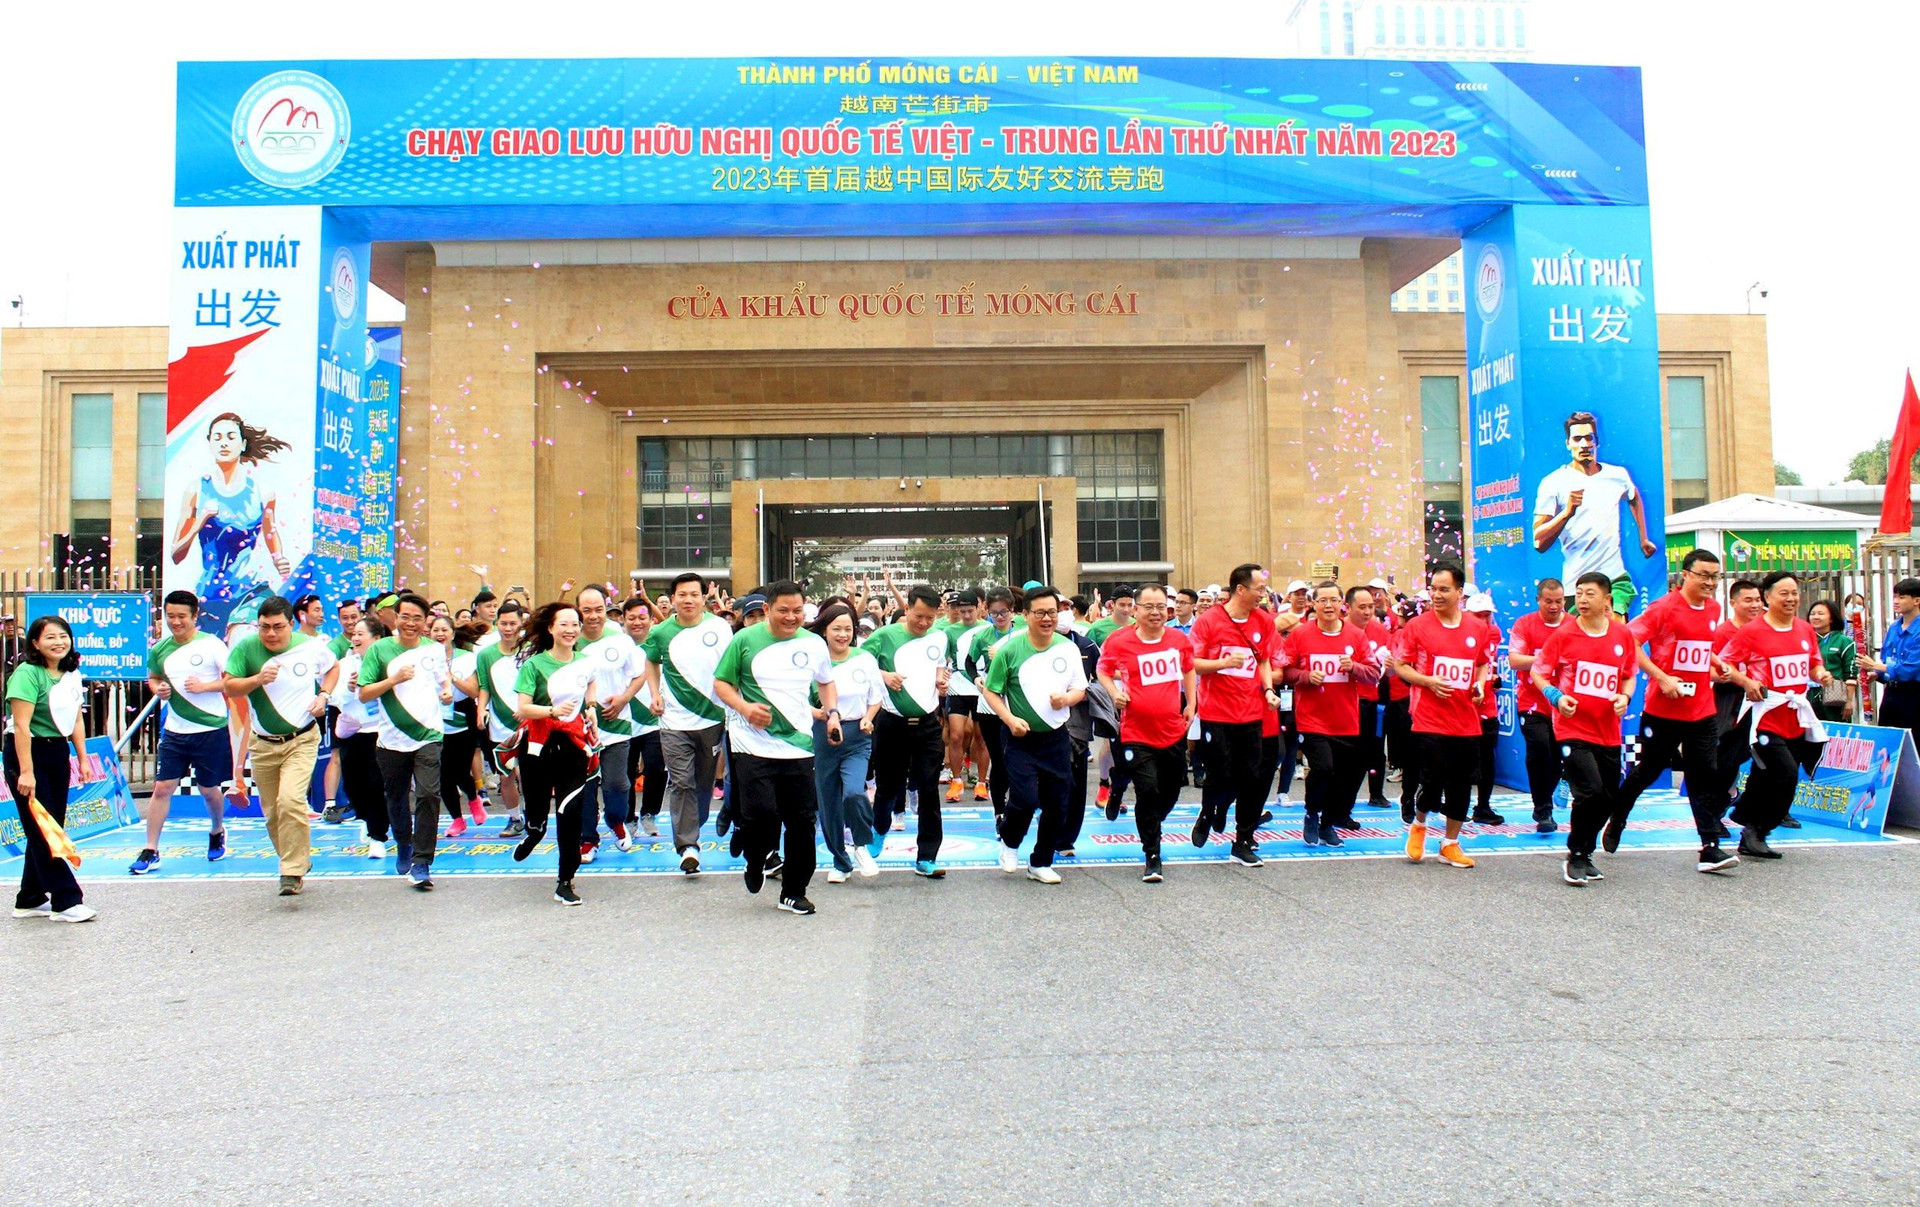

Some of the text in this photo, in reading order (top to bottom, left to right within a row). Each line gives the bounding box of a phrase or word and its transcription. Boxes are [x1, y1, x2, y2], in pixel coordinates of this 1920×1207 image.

[738, 61, 816, 84] THÀNH
[823, 60, 873, 84] PHỐ
[880, 62, 951, 84] MÓNG
[958, 62, 998, 84] CÁI
[1027, 63, 1077, 88] VIỆT
[1083, 65, 1138, 84] NAM
[839, 94, 991, 114] 越南芒街市
[407, 128, 483, 162] CHẠY
[491, 129, 560, 156] GIAO
[568, 127, 624, 155] LƯU
[632, 122, 692, 155] HỮU
[701, 128, 772, 160] NGHỊ
[781, 119, 860, 157] QUỐC
[870, 118, 907, 155] TẾ
[911, 128, 972, 160] VIỆT
[1003, 128, 1098, 155] TRUNG
[1107, 119, 1165, 155] LẦN
[1171, 123, 1228, 155] THỨ
[1234, 119, 1308, 155] NHẤT
[1316, 122, 1382, 156] NĂM
[1390, 129, 1457, 157] 2023
[712, 164, 1165, 193] 2023年首届越中国际友好交流竞跑
[182, 231, 300, 269] XUẤT PHÁT
[1531, 249, 1642, 286] XUẤT PHÁT
[195, 288, 281, 328] 出发
[667, 280, 1139, 322] CỬA KHẨU QUỐC TẾ MÓNG CÁI
[1549, 304, 1631, 343] 出发
[320, 358, 360, 402] XUẤT PHÁT
[1471, 350, 1514, 396] XUẤT PHÁT
[324, 410, 354, 455] 出发
[1478, 403, 1511, 447] 出发
[58, 607, 89, 624] KHU
[1142, 656, 1178, 678] 001
[1436, 663, 1471, 683] 005
[1677, 646, 1711, 665] 007
[1774, 660, 1808, 680] 008
[1578, 668, 1618, 692] 006
